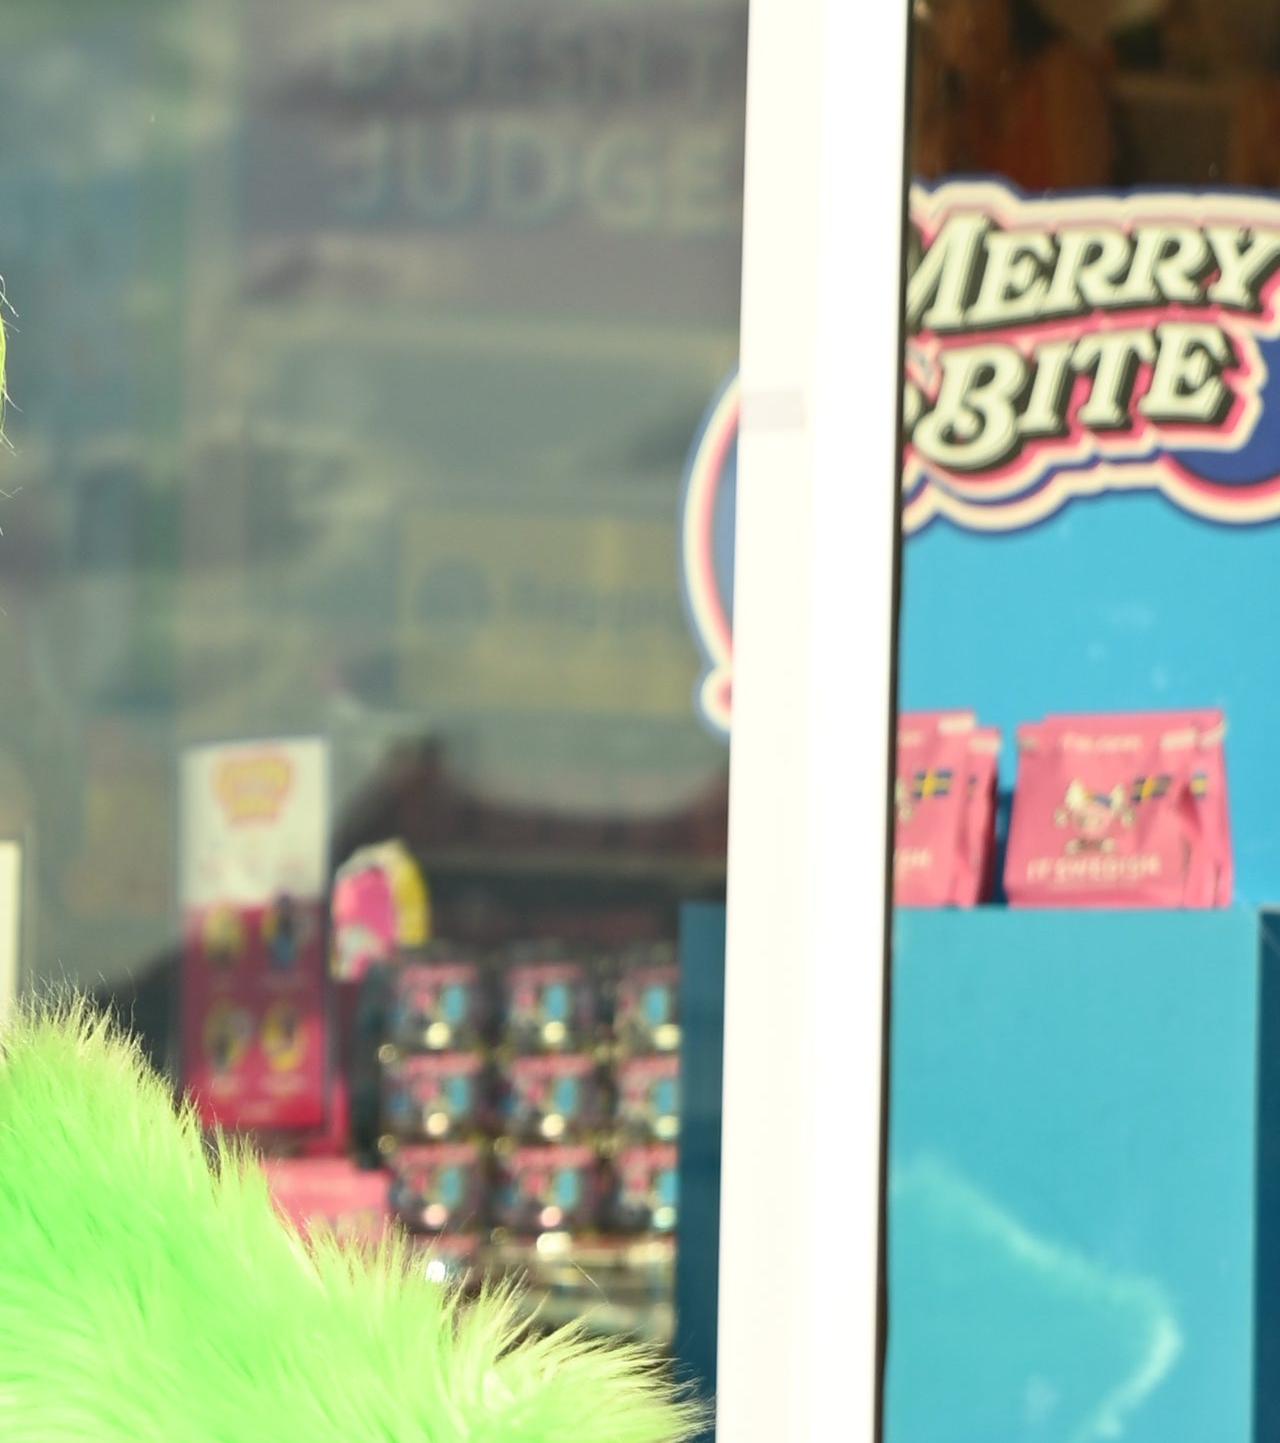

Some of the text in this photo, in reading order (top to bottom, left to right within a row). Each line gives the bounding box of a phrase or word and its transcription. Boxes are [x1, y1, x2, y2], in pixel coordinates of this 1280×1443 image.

[324, 107, 736, 233] JUDGE
[905, 213, 1280, 331] MERRY
[912, 321, 1230, 472] BITE
